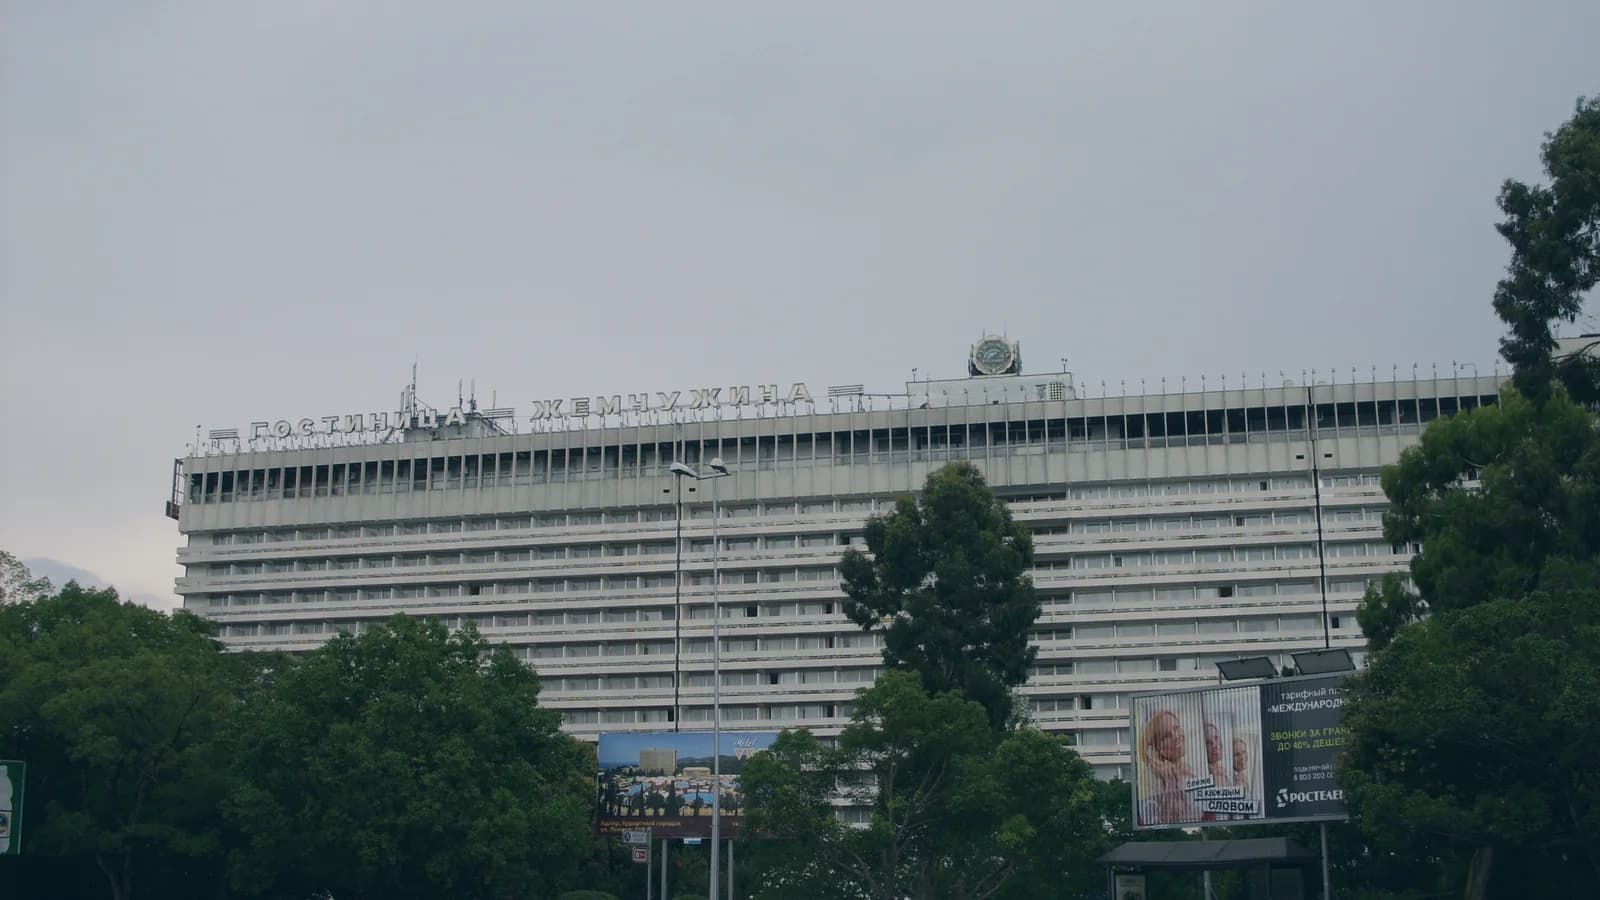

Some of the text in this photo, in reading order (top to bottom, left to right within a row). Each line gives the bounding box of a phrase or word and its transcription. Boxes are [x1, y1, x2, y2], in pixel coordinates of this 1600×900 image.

[250, 382, 815, 440] ГОСТИНИЦА ЖЕМЧУЖИНА
[1281, 688, 1326, 700] тарифный
[1268, 698, 1349, 712] «МЕЖДУНАРОДН
[1271, 729, 1306, 740] ЗВОНКИ
[1309, 728, 1320, 738] ЗА
[1277, 742, 1291, 752] ДО
